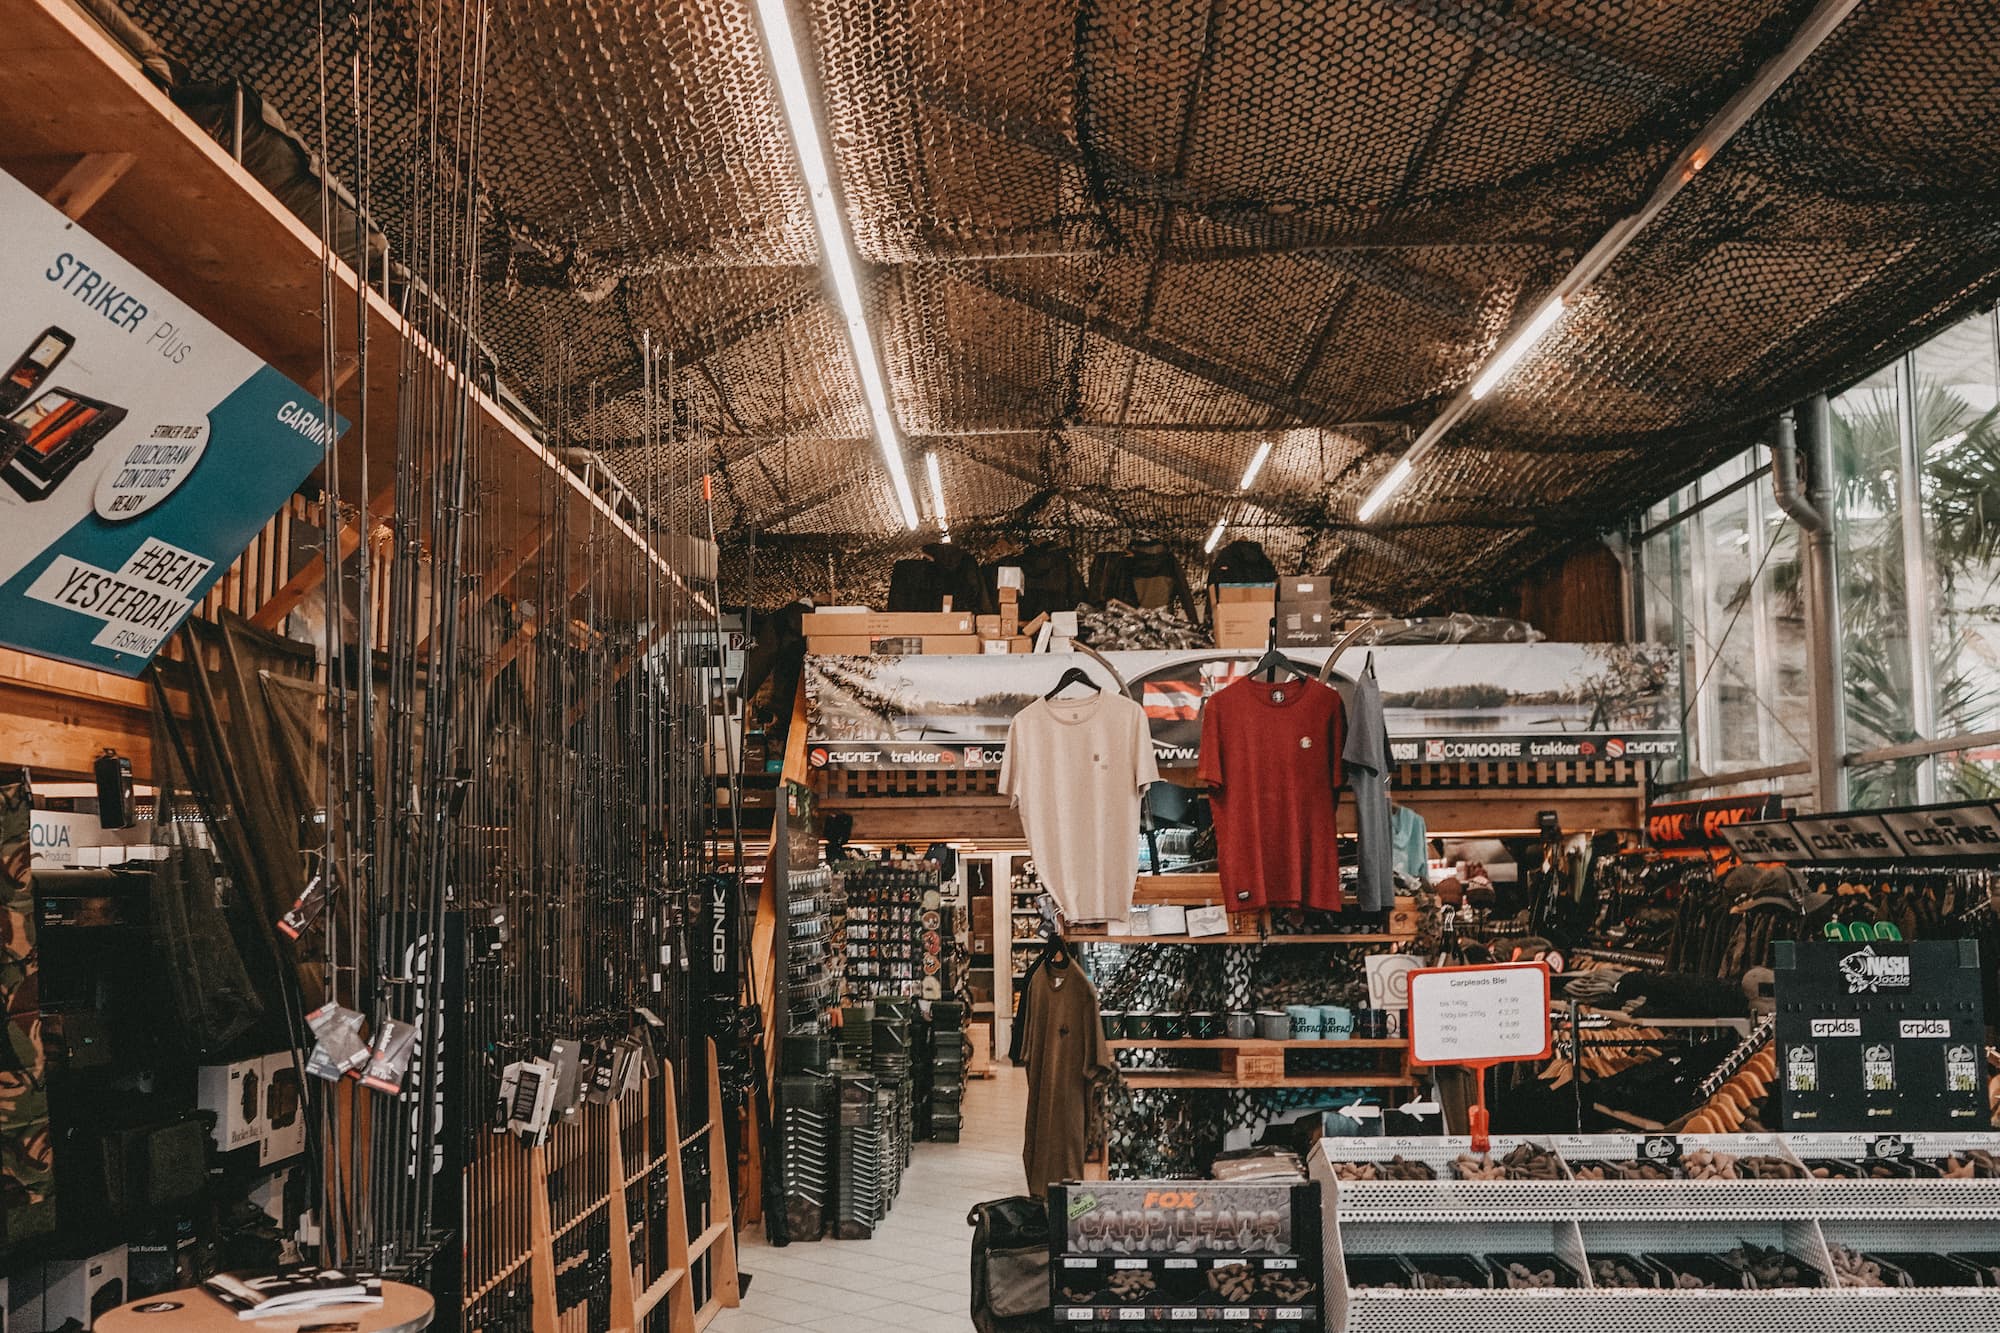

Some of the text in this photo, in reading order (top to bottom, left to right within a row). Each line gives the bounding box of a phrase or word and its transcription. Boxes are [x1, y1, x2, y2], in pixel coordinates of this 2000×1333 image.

[46, 253, 148, 333] STRIKER
[125, 445, 197, 466] QUICKDRAW
[112, 469, 176, 488] CONTOURS
[108, 495, 147, 511] READY
[129, 545, 209, 592] #BEAT
[54, 567, 185, 633] YESTERDAY.
[111, 630, 158, 654] FISHING
[828, 751, 941, 763] CYGNET trakker
[1444, 743, 1521, 757] CCMOORE
[1530, 741, 1581, 756] trakker
[1625, 742, 1678, 754] CYGNET
[1649, 813, 1685, 841] FOX
[1904, 825, 2000, 846] CLOTHING
[1811, 832, 1889, 850] CLOTHING
[713, 884, 726, 973] SONIK
[1866, 956, 1910, 976] NASH
[1450, 979, 1490, 987] Carpleads
[1143, 1191, 1199, 1209] FOX
[1079, 1209, 1282, 1238] CARP LEADS
